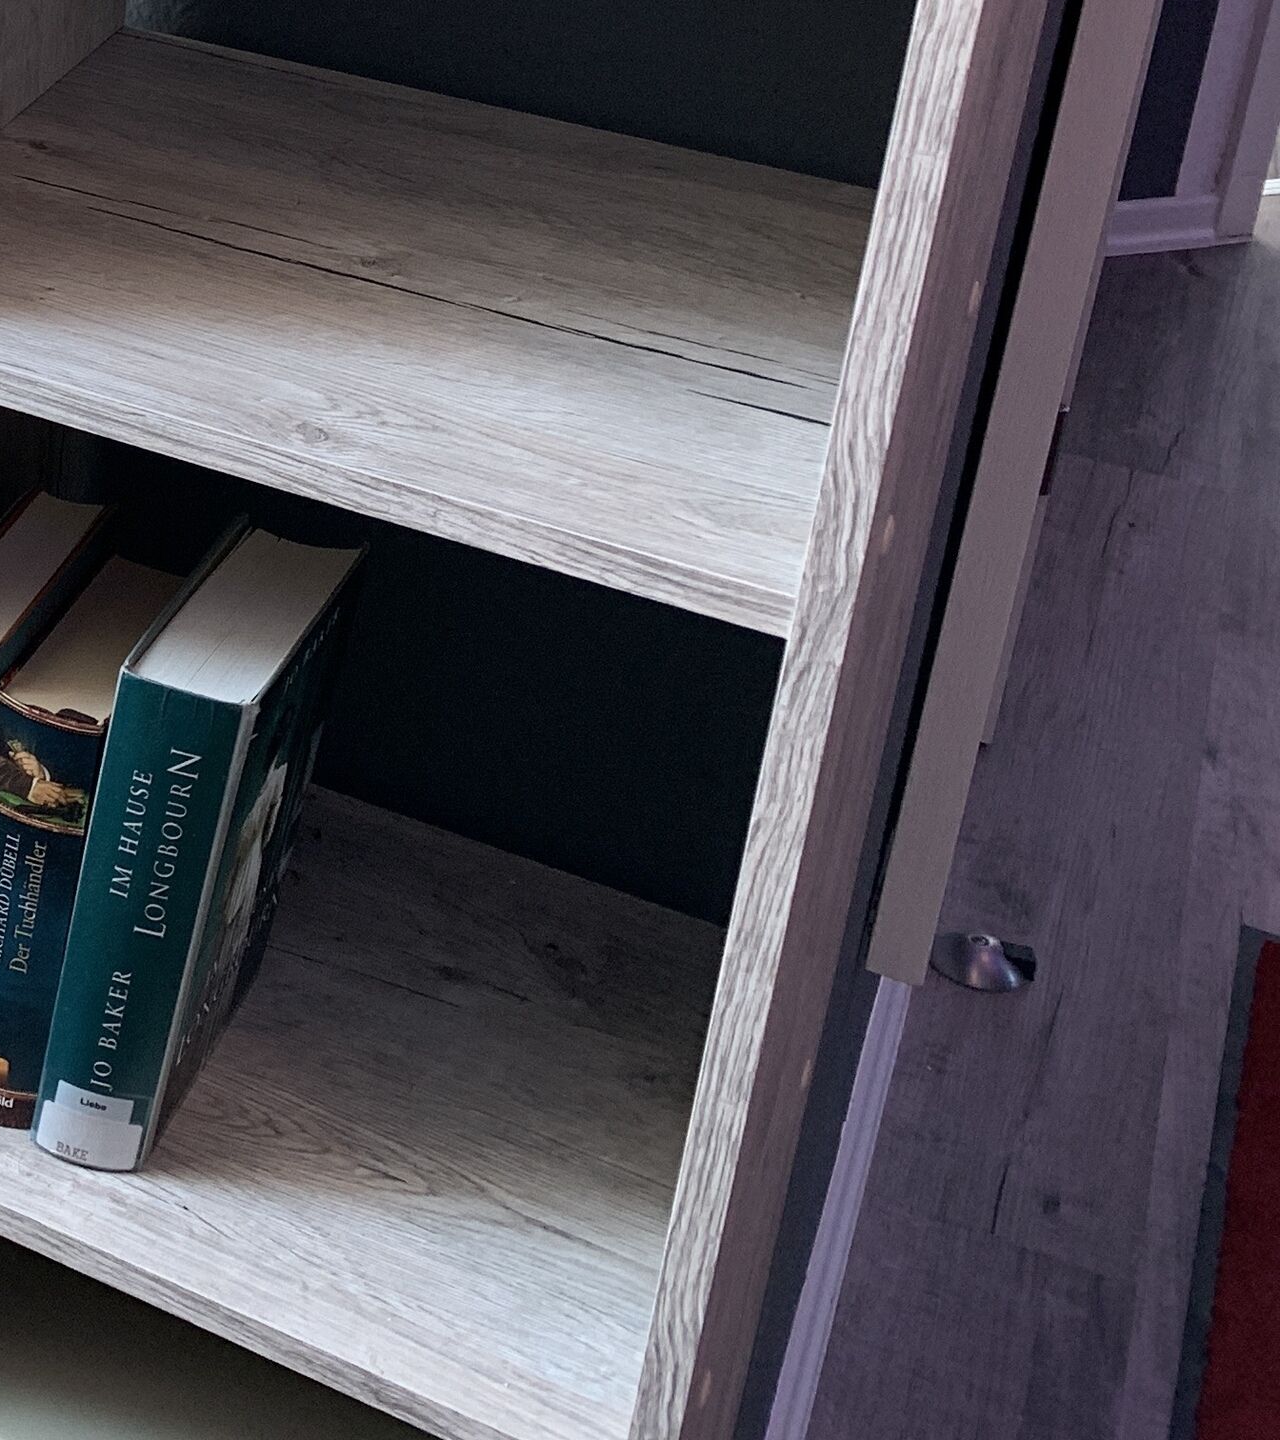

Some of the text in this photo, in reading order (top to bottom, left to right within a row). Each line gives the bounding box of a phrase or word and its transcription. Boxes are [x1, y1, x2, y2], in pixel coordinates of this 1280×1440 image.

[109, 769, 153, 899] IM HAUSE
[133, 746, 203, 939] LONGBOURN
[9, 840, 48, 975] Der Tuchhändler
[90, 970, 132, 1093] JO BAKER
[55, 1141, 89, 1161] BAKE
